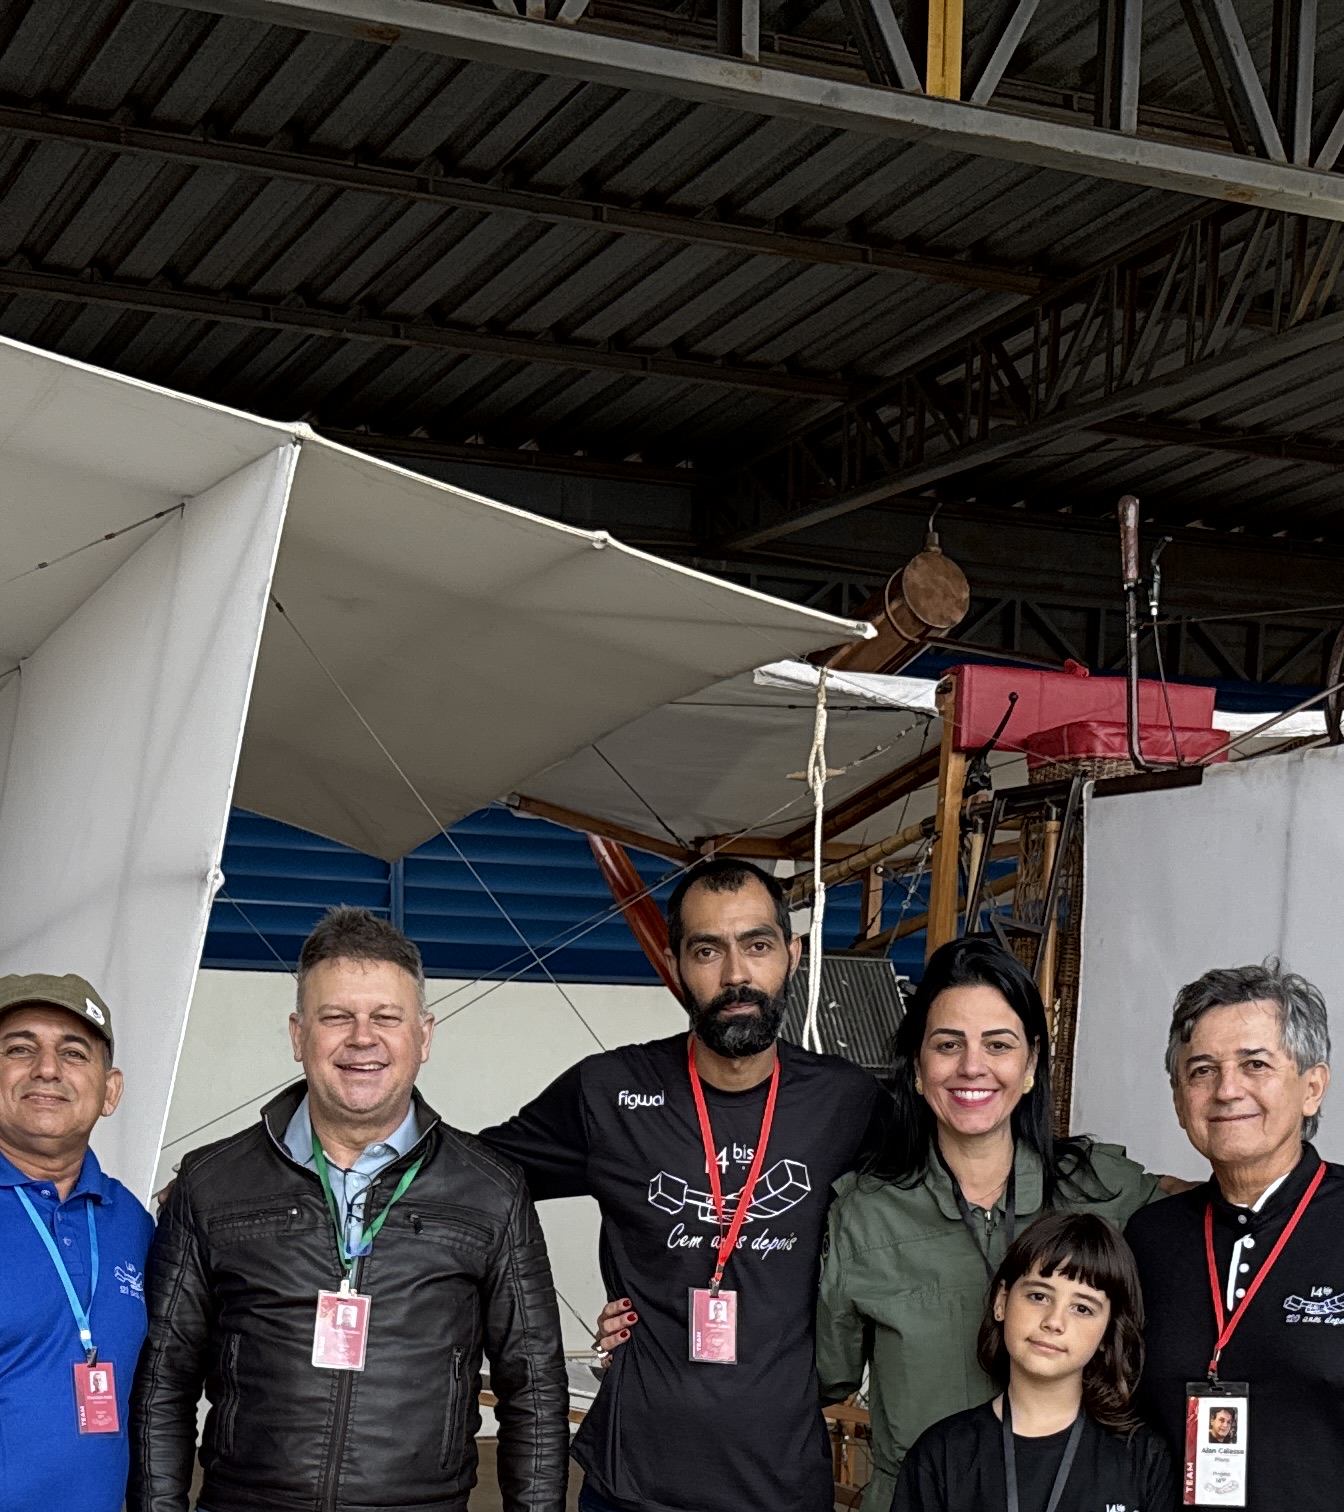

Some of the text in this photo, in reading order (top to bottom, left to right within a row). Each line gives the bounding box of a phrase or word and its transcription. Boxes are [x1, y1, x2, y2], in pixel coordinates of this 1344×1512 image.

[618, 1089, 665, 1110] figwal
[732, 1142, 755, 1160] bis
[667, 1222, 798, 1261] Cem as depois
[1186, 1462, 1194, 1493] TEAM
